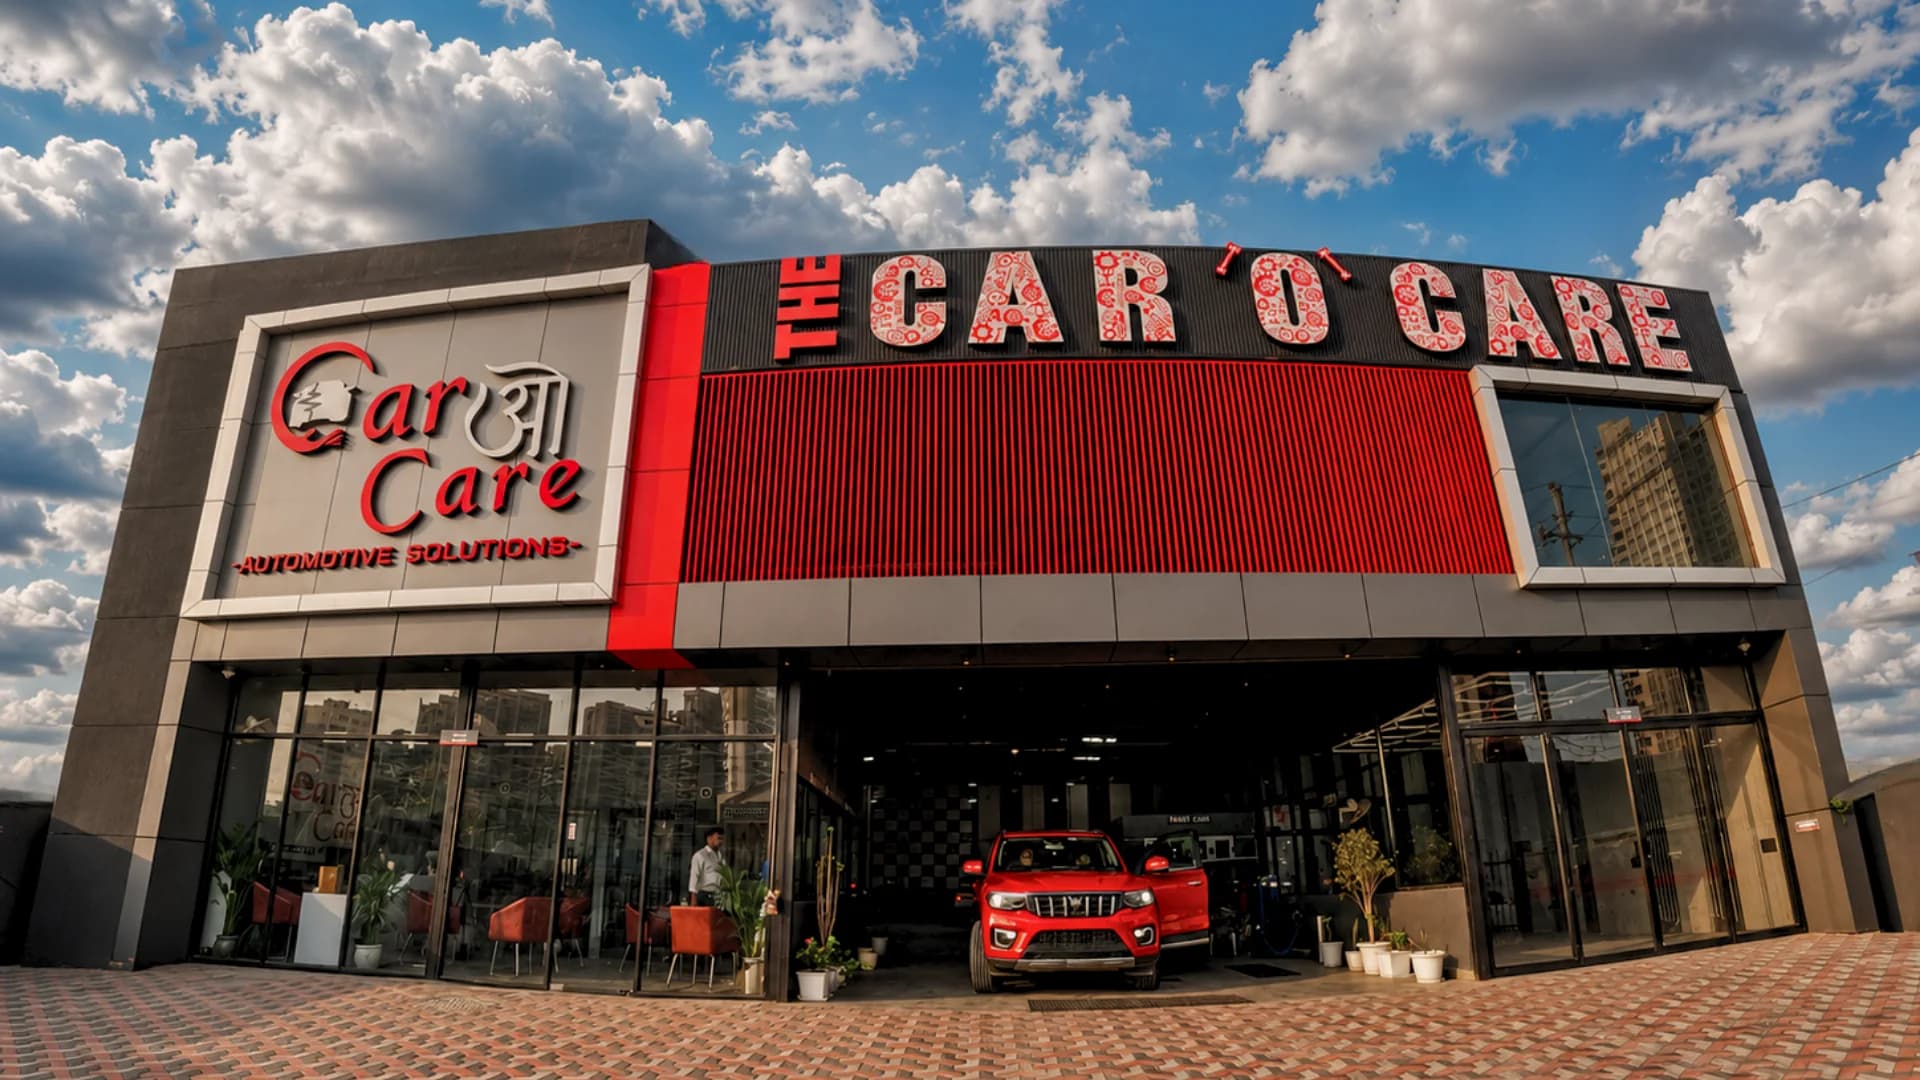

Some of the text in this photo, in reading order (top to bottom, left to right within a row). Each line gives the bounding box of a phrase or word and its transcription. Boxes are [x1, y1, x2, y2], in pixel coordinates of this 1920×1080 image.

[774, 252, 842, 360] THE
[869, 249, 1178, 347] CAR
[1390, 261, 1693, 373] CARE
[270, 341, 471, 454] Car
[360, 448, 583, 535] Care
